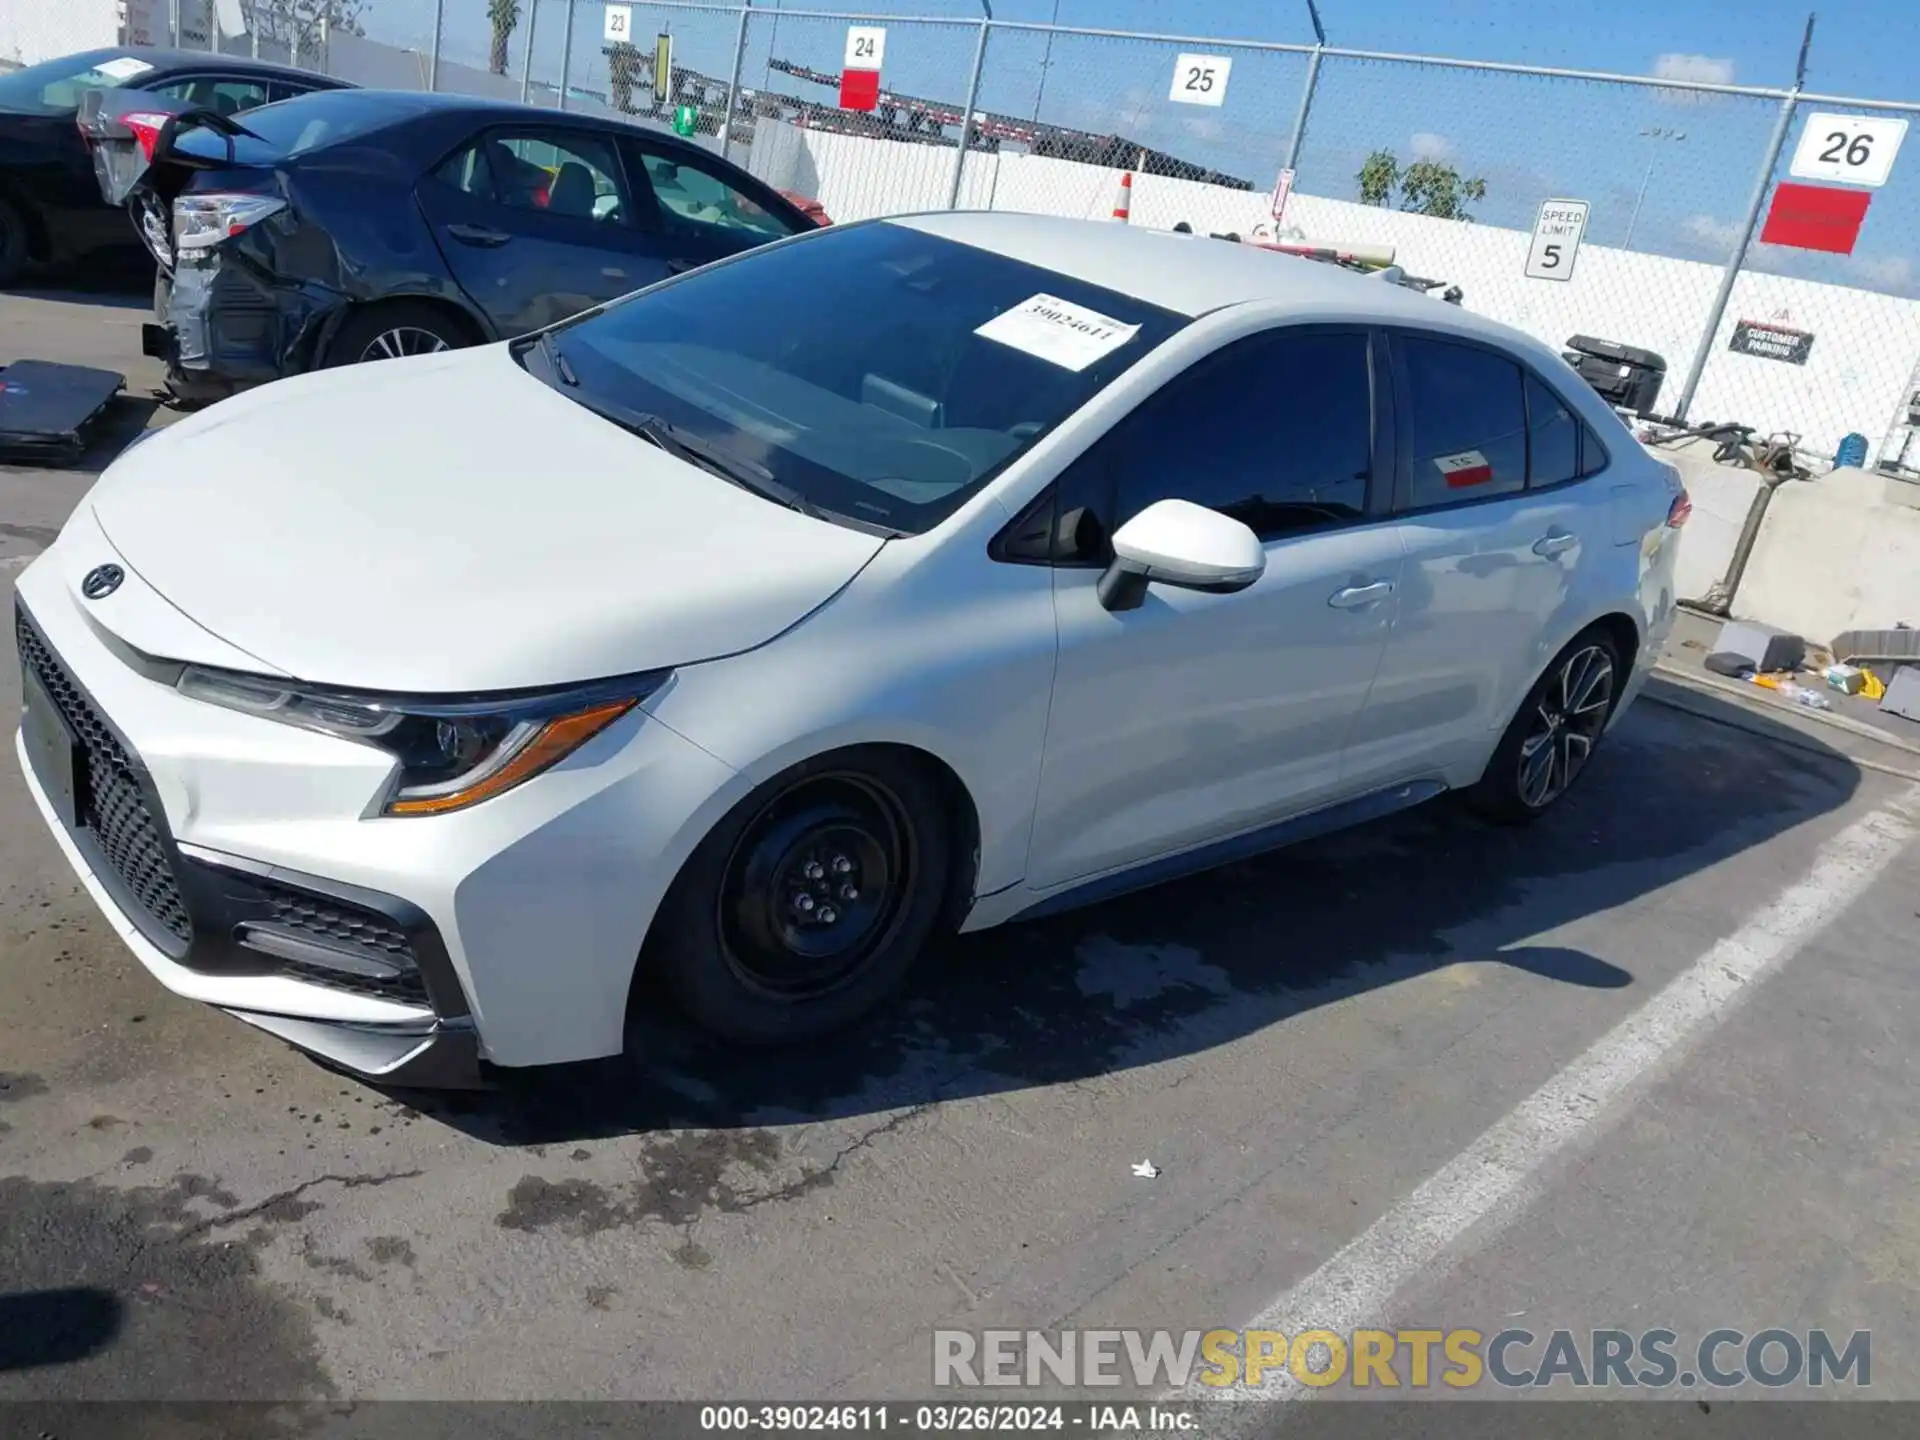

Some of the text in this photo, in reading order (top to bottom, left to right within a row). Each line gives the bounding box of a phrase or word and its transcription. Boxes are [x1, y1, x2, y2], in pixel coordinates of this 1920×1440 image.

[611, 14, 624, 32] 23
[855, 36, 874, 57] 24
[1185, 66, 1215, 92] 25
[1818, 131, 1875, 167] 26
[1542, 210, 1583, 223] SPEED
[1542, 225, 1576, 236] LIMIT
[1541, 245, 1562, 269] 5
[1025, 304, 1114, 340] 39024611
[1747, 327, 1800, 347] CUSTOMER
[1747, 339, 1791, 357] PARKING
